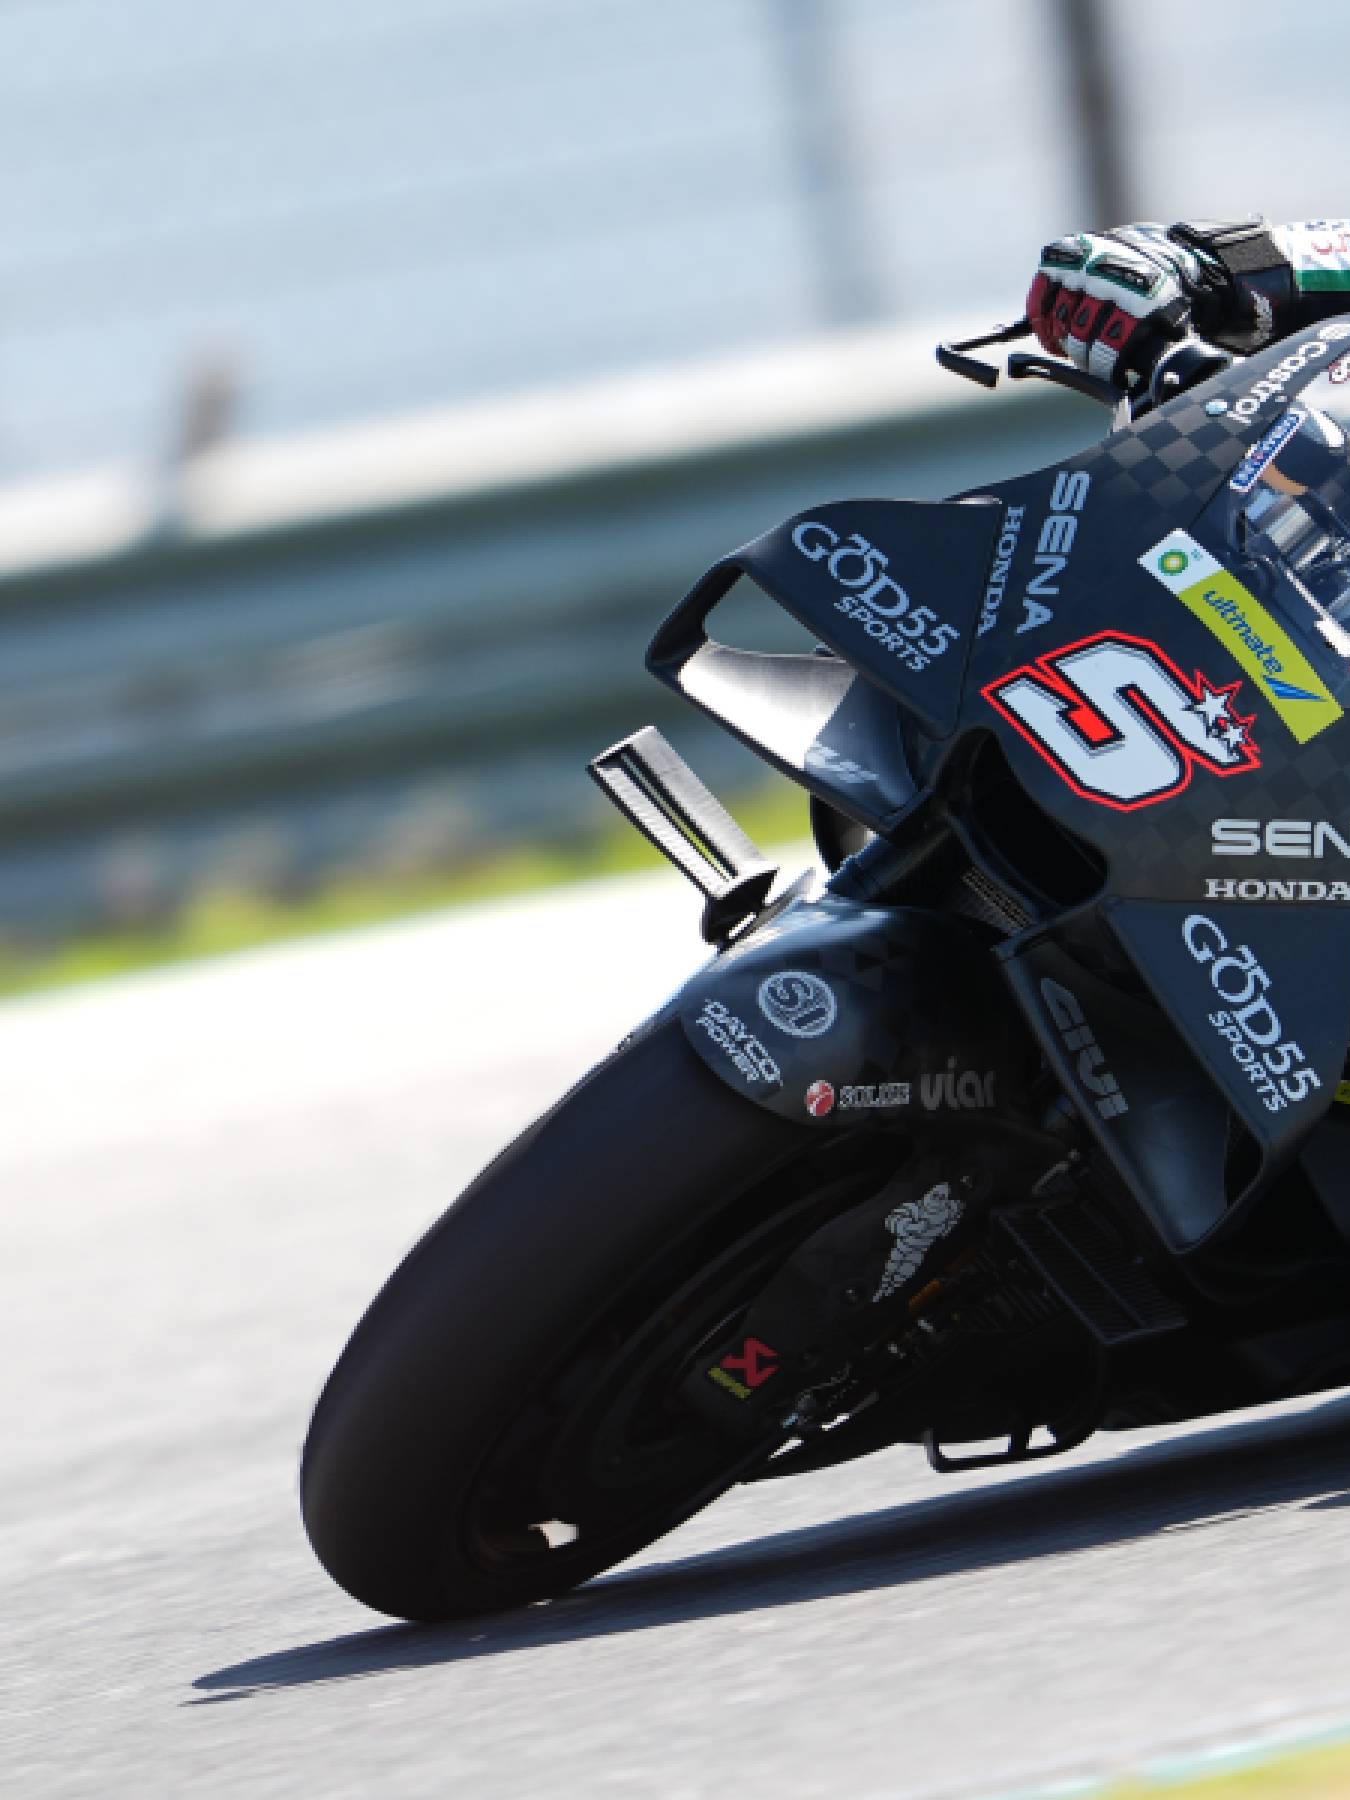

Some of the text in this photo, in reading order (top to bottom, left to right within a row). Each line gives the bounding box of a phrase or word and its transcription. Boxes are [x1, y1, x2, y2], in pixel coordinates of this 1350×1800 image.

[976, 505, 1026, 637] HONDA
[1016, 470, 1090, 635] SENA
[833, 596, 931, 673] SPORTS
[1203, 590, 1284, 675] ultimate
[980, 630, 1260, 812] 5
[1040, 977, 1129, 1120] GIVI
[1208, 1010, 1288, 1113] SPORTS
